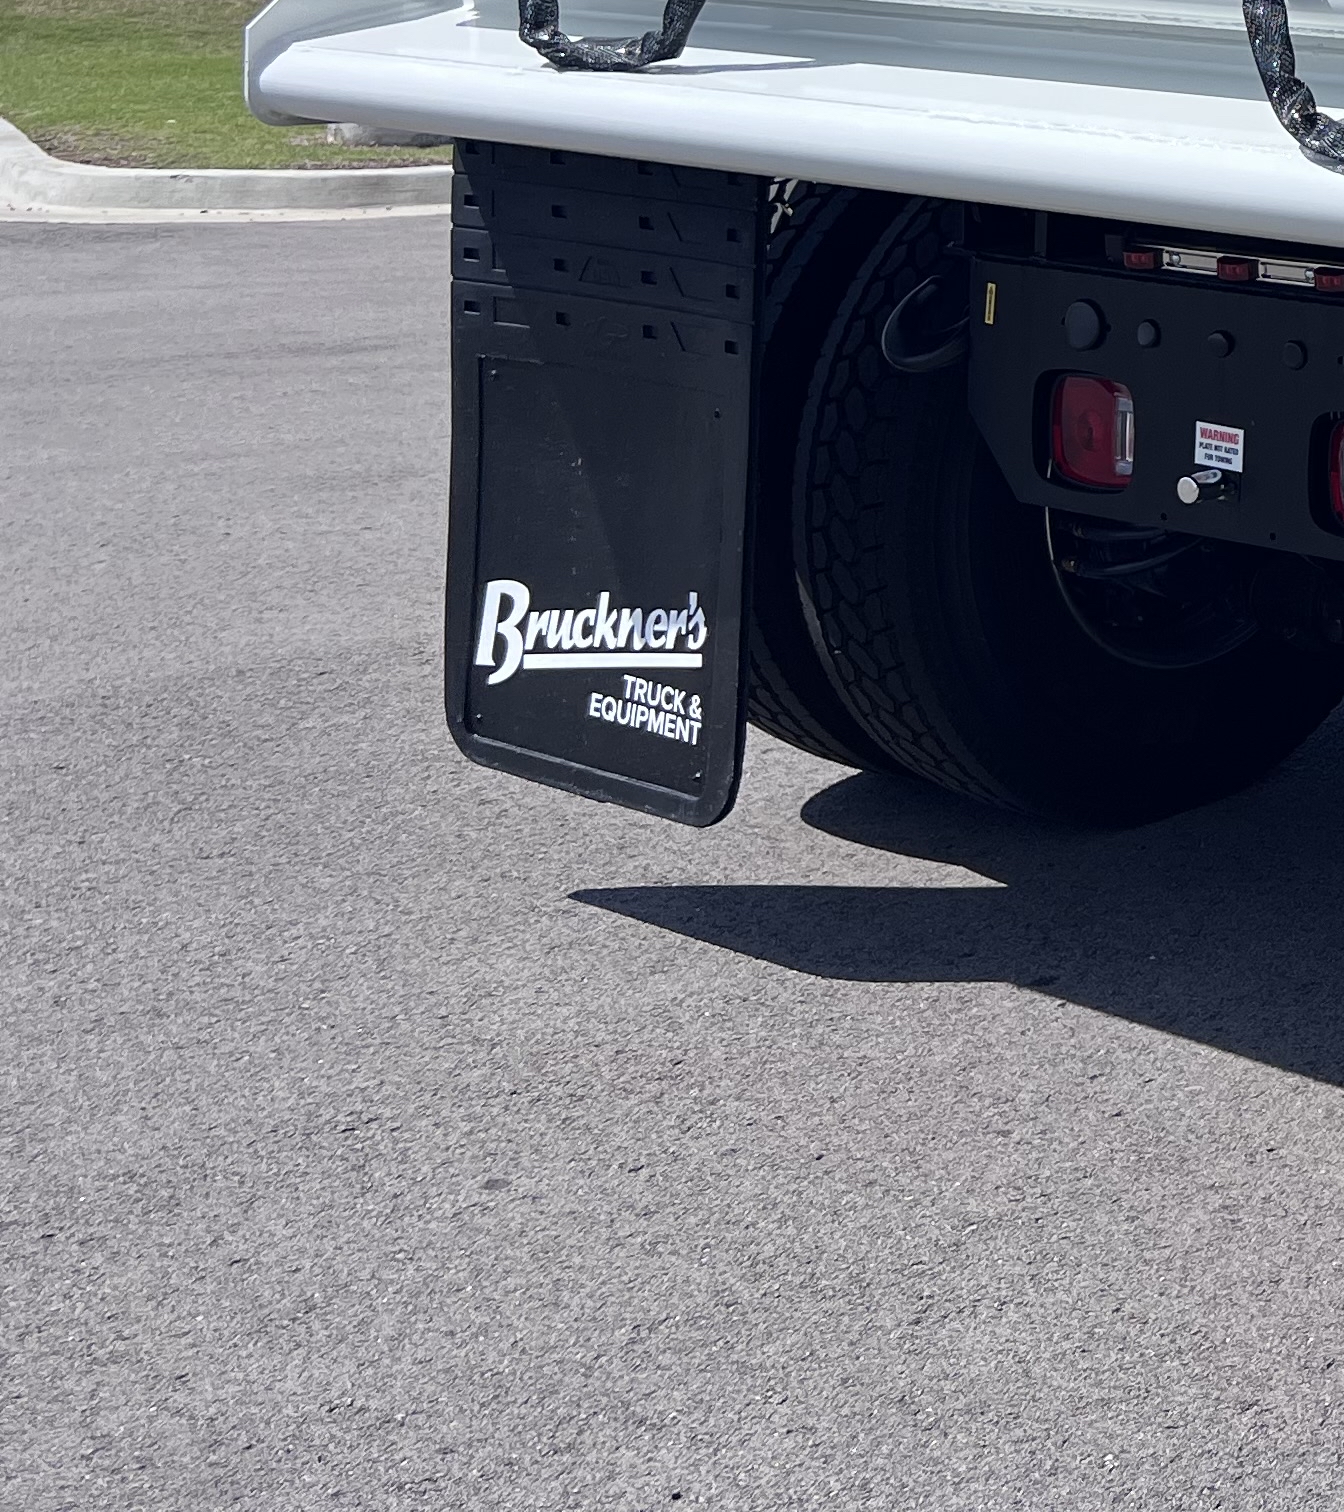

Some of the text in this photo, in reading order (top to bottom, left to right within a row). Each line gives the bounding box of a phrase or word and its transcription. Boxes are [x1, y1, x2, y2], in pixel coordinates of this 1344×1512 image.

[1200, 427, 1239, 445] WARNING
[473, 579, 708, 685] Bruckner's
[588, 692, 702, 745] EQUIPMENT
[622, 674, 702, 719] TRUCK &
